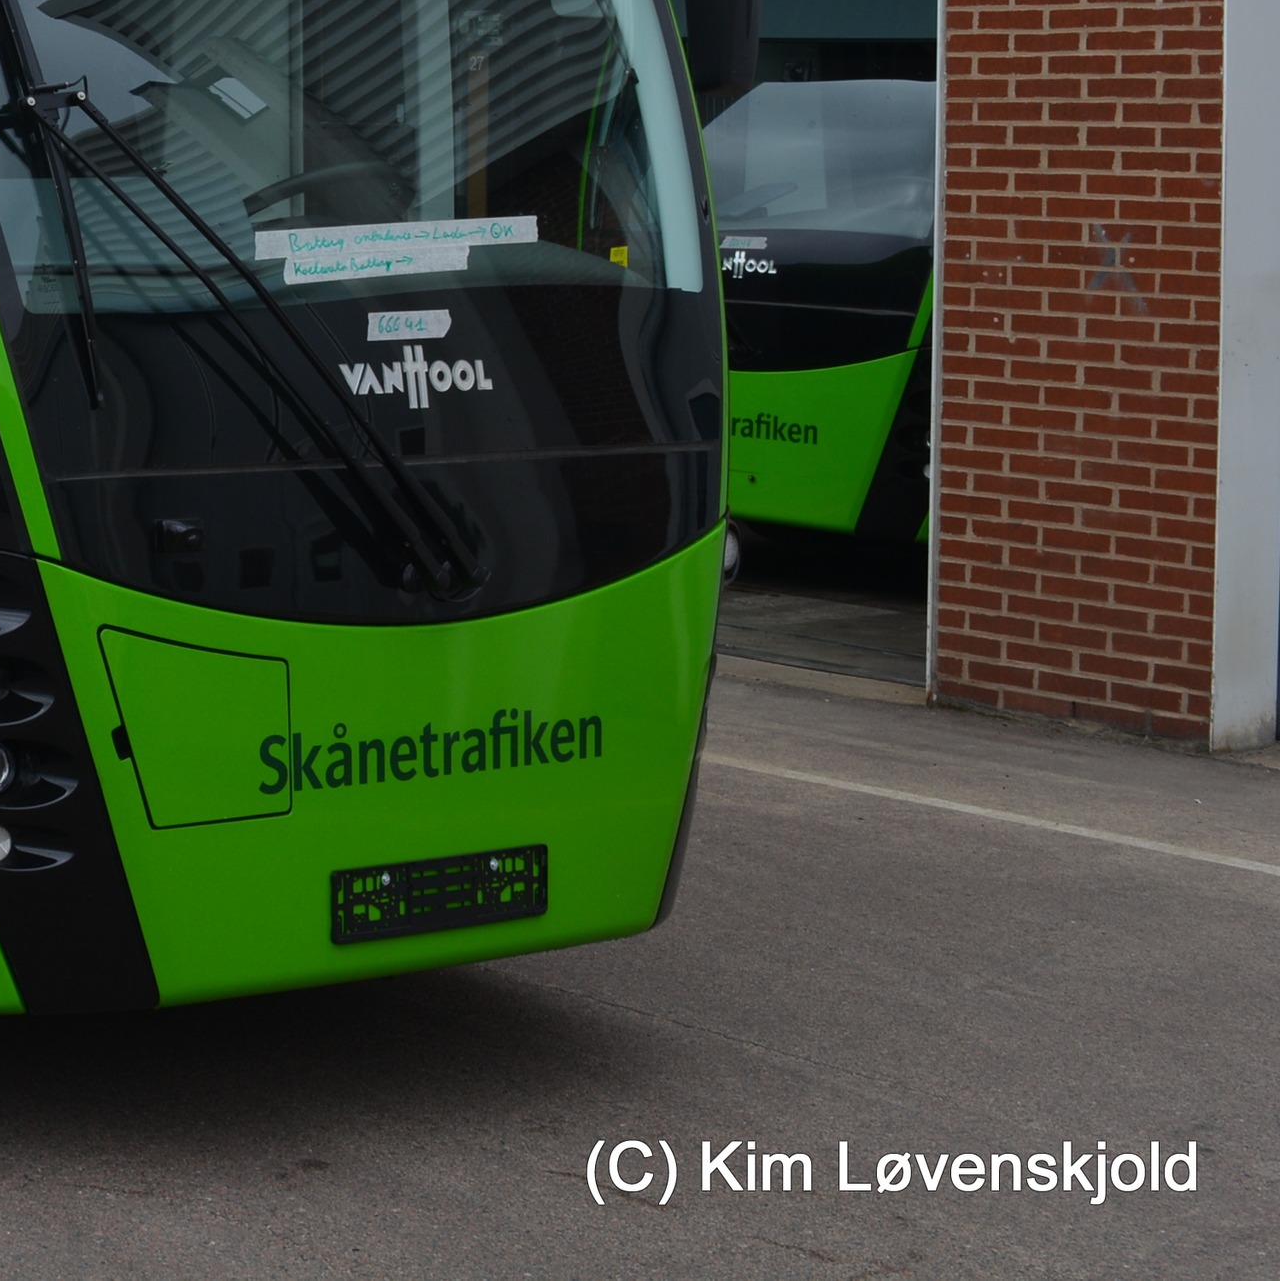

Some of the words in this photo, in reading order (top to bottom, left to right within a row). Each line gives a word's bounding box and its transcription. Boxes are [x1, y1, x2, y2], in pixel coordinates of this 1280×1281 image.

[721, 250, 777, 279] NHOOL
[730, 411, 819, 445] rafiken
[258, 707, 603, 795] Skånetrafiken
